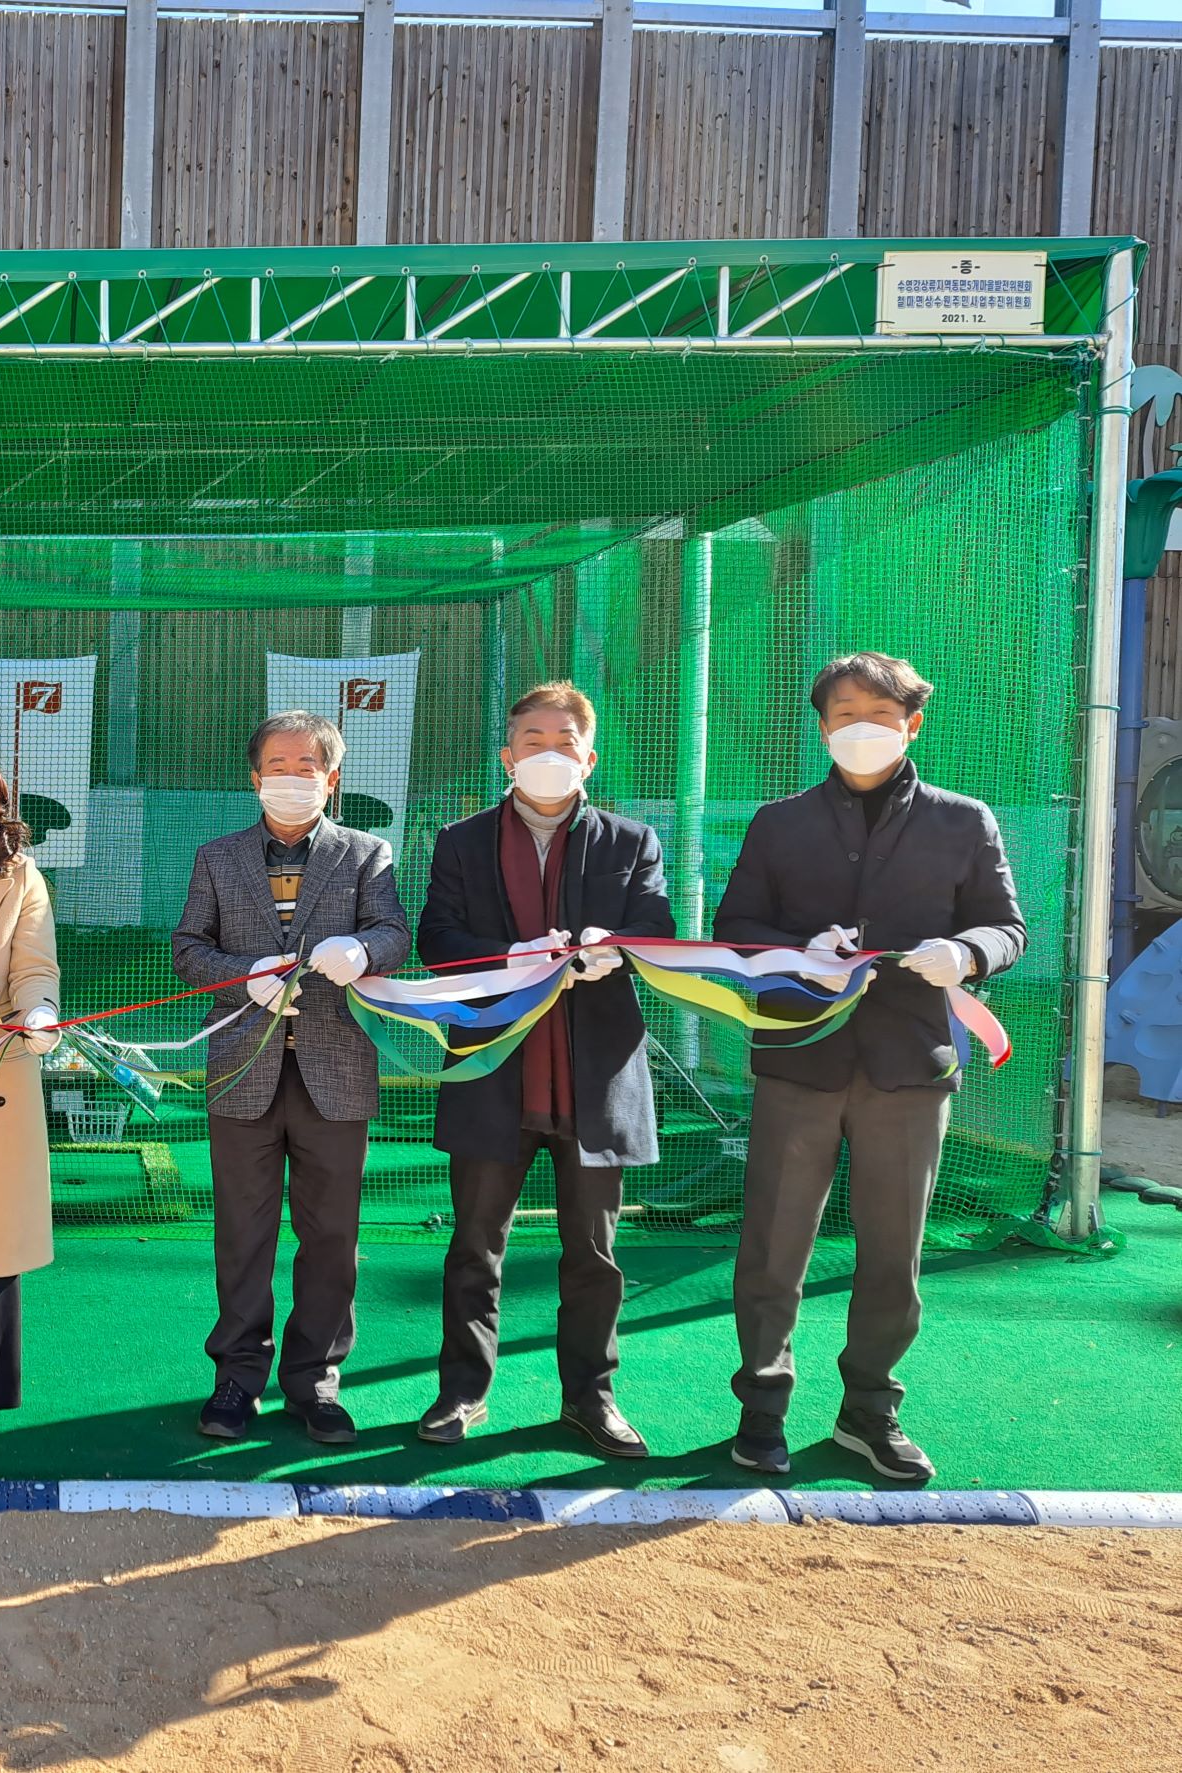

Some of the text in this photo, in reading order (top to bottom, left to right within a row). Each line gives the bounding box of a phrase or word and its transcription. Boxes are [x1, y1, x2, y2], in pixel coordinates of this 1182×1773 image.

[941, 314, 986, 323] 2021. 12.
[31, 686, 56, 711] 7
[354, 684, 380, 708] 7
